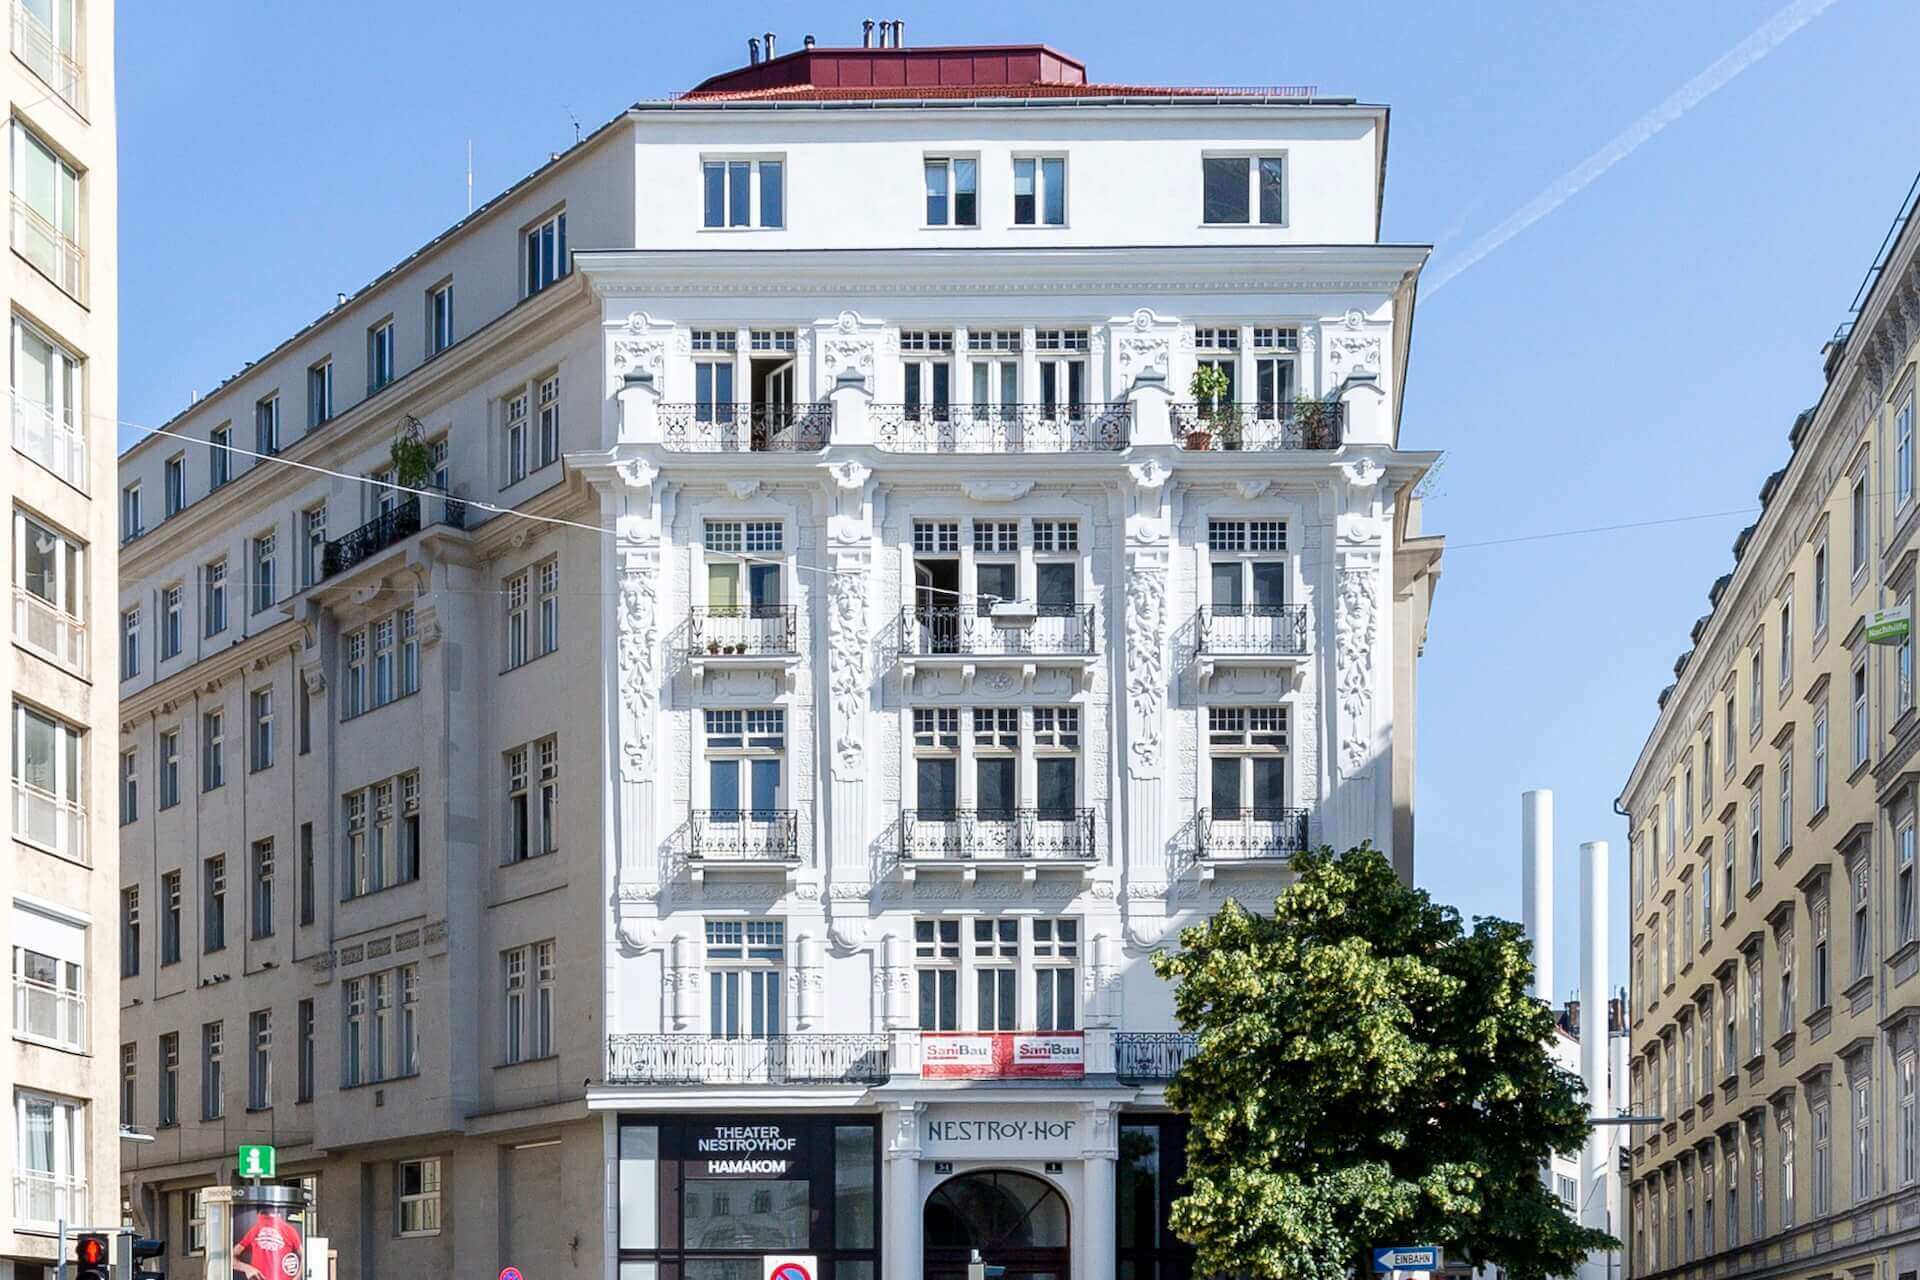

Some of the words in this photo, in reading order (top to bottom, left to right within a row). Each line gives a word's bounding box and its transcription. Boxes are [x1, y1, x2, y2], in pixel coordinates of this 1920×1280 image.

[927, 1043, 987, 1056] SaniBau
[1019, 1042, 1080, 1055] SaniBau
[714, 1126, 780, 1139] THEATER
[928, 1121, 1076, 1141] NESTROY-HOF
[698, 1138, 796, 1151] NESTROYHOF
[708, 1160, 786, 1173] HAMAKOM
[1394, 1254, 1431, 1265] EINBAHN
